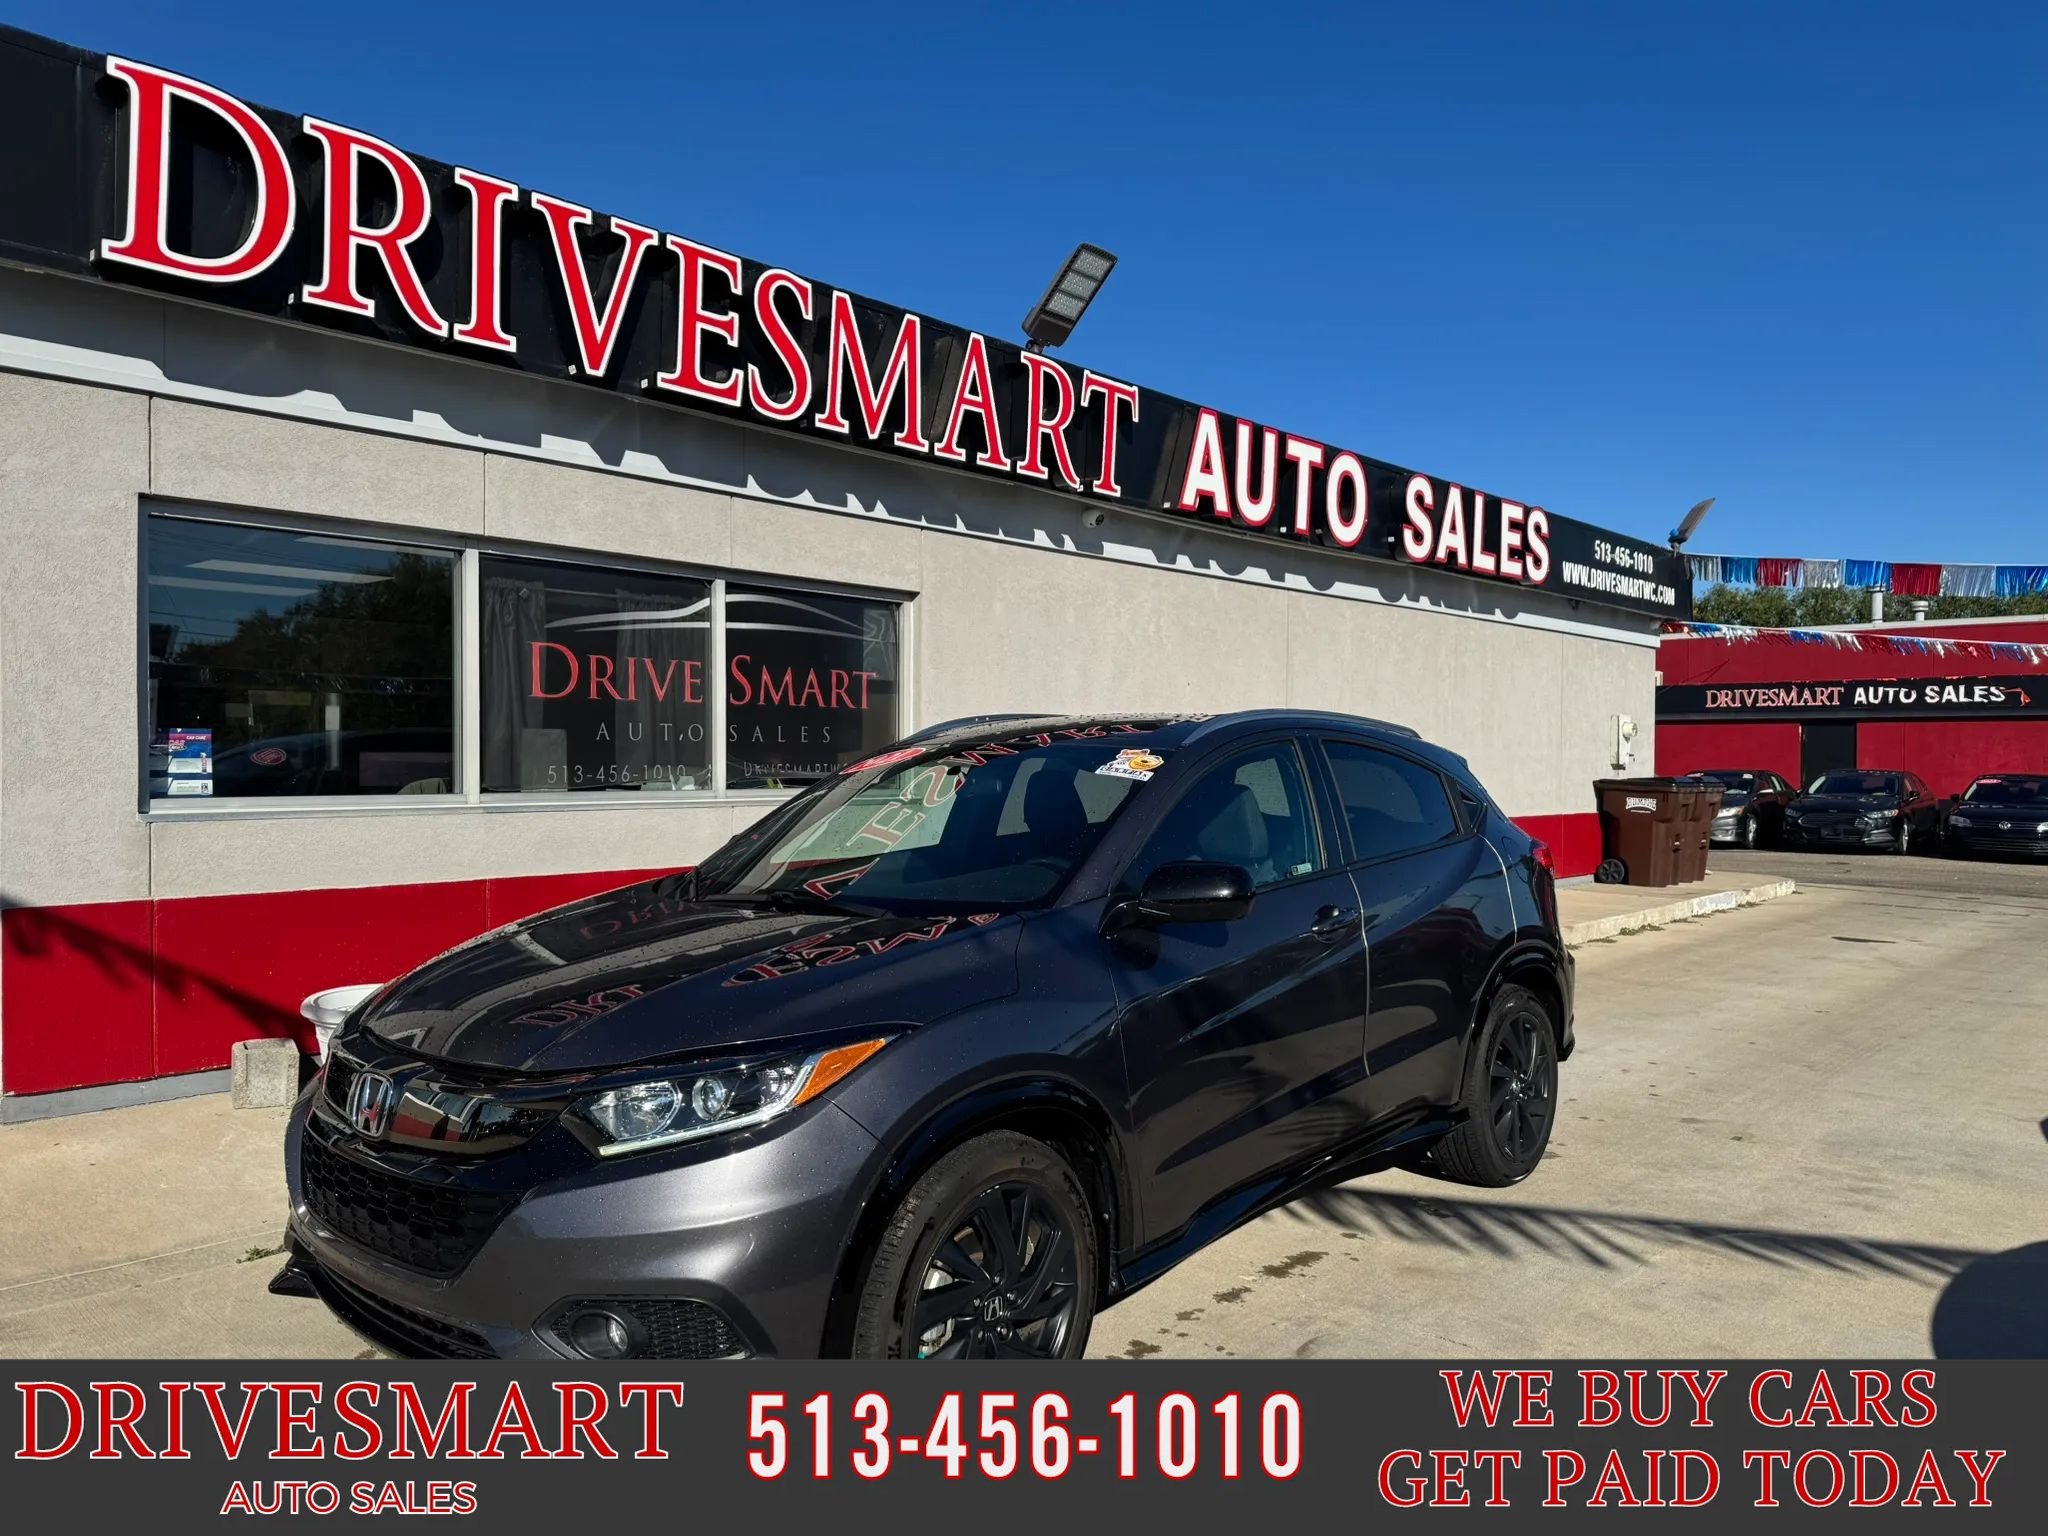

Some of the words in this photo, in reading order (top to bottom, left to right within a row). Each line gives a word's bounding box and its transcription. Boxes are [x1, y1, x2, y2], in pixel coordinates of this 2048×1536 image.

[99, 54, 1139, 499] DRIVESMART
[1177, 407, 1369, 548] AUTO
[1400, 472, 1551, 586] SALES
[1594, 539, 1654, 575] 513-456-1010
[1561, 560, 1676, 606] WWW.DRIVESMARTWC.COM
[1704, 685, 1845, 708] DRIVESMART
[1853, 686, 1917, 706] AUTO
[1924, 684, 2007, 704] SALES
[596, 721, 705, 743] AUTO
[728, 723, 833, 744] SALES
